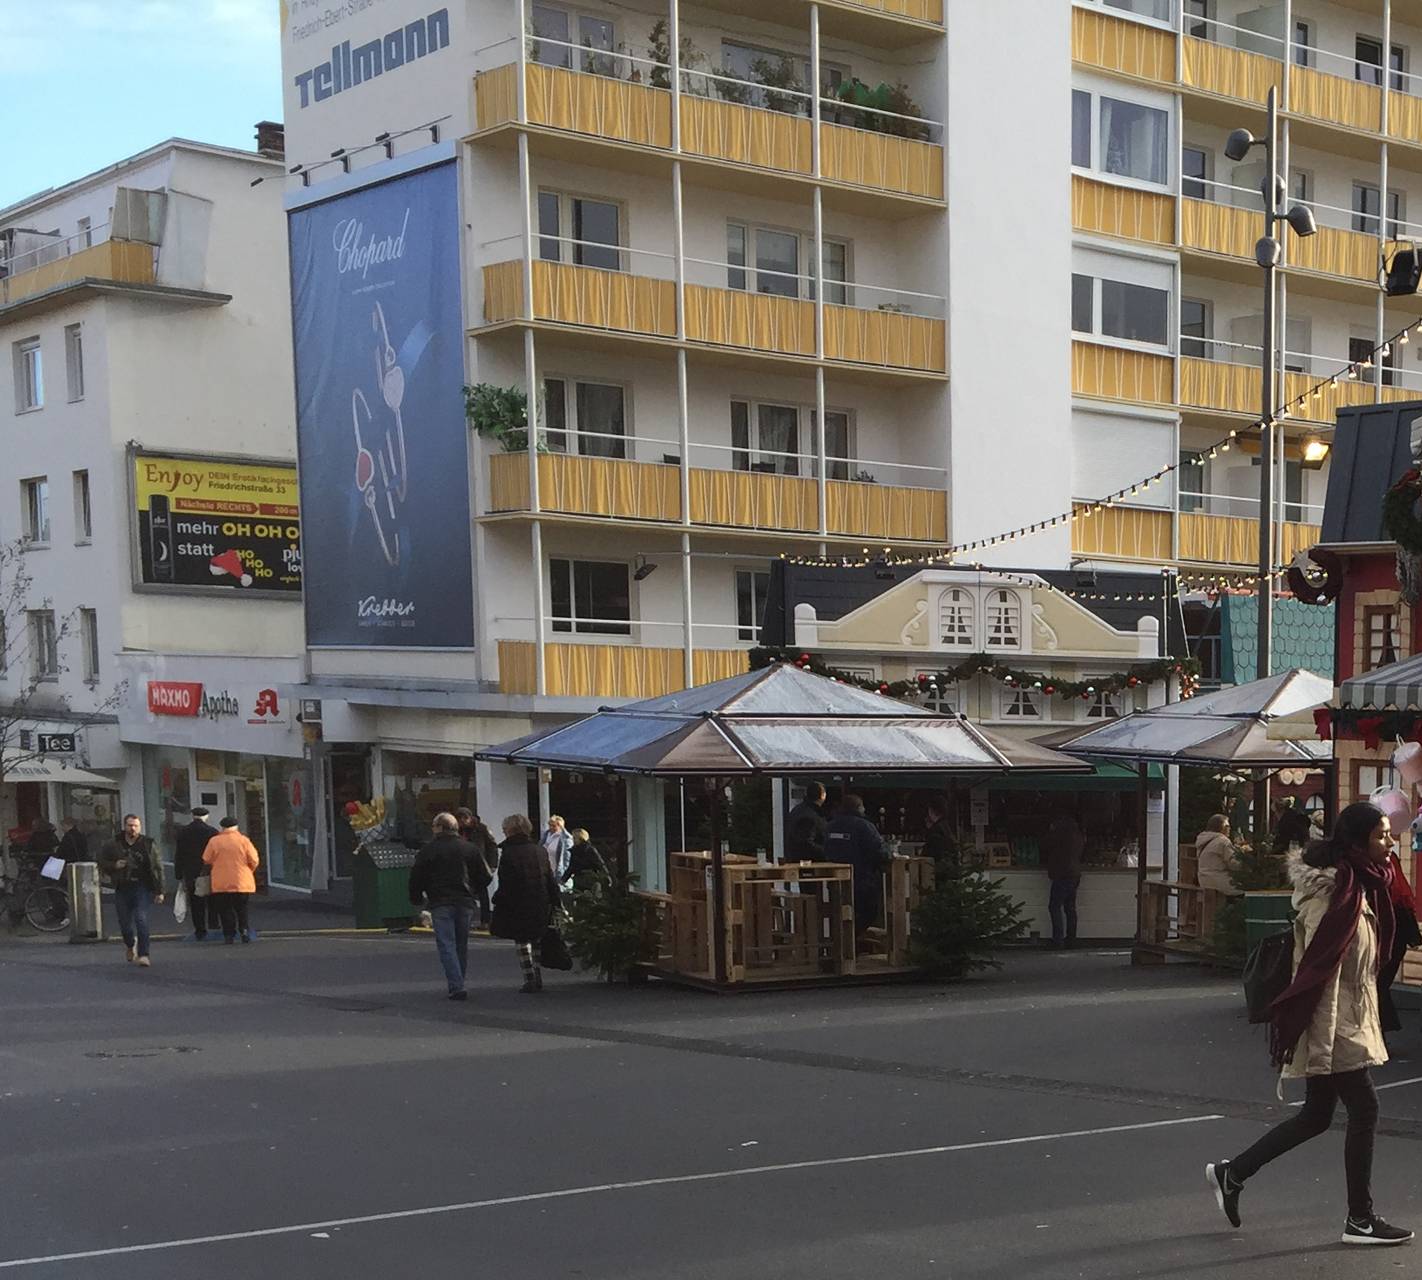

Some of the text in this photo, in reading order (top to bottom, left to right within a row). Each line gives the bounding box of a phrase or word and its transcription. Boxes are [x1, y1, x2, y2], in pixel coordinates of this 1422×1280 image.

[295, 7, 449, 109] Tellmann
[333, 207, 410, 279] Chopard
[145, 463, 204, 492] Enjoy
[208, 481, 274, 494] Friedrichstraße
[216, 503, 252, 513] RECHTS
[176, 521, 299, 540] mehr OH OH O
[177, 542, 215, 557] statt
[245, 559, 264, 568] HO
[255, 568, 273, 578] HO
[152, 687, 240, 722] MAXMO Apothe
[41, 735, 71, 751] Tee
